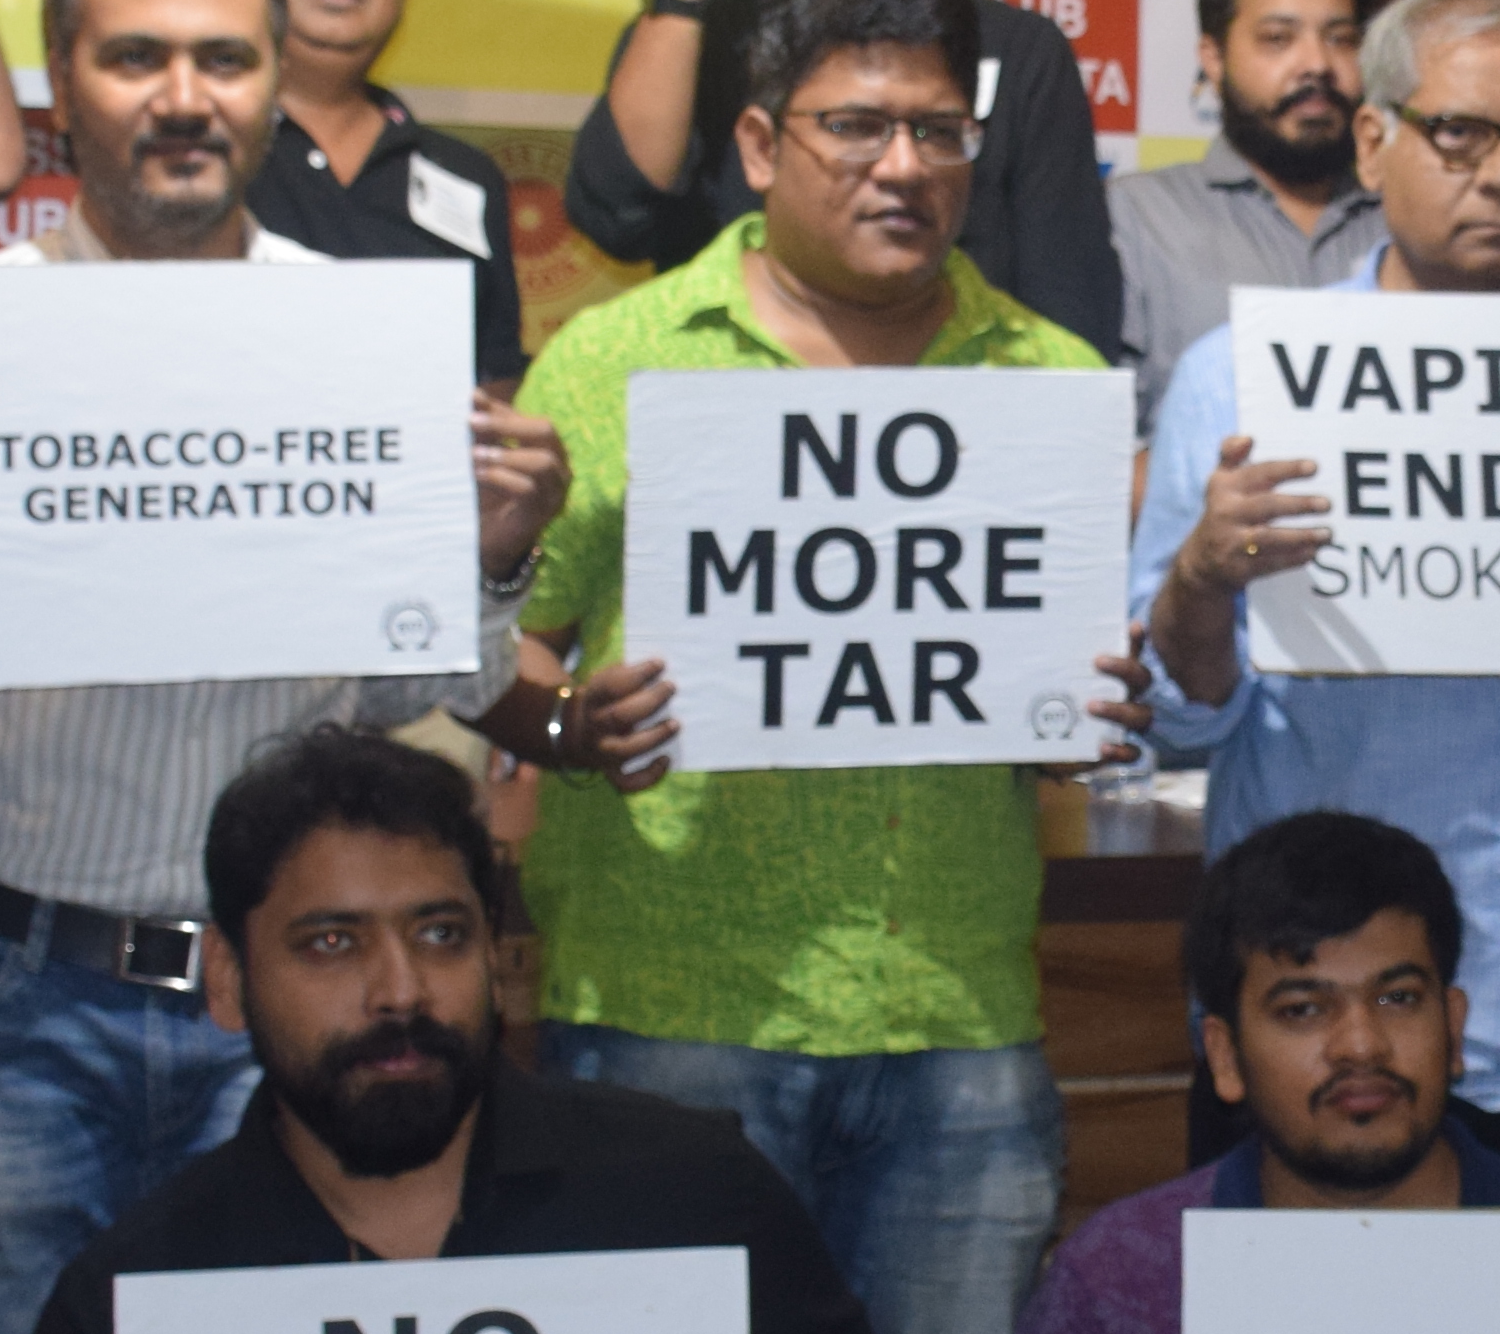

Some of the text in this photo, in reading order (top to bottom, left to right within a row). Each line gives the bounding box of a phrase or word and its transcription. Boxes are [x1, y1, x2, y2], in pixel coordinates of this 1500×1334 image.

[781, 411, 959, 500] NO
[24, 481, 375, 524] GENERATION
[687, 526, 1043, 616] MORE
[739, 639, 987, 729] TAR
